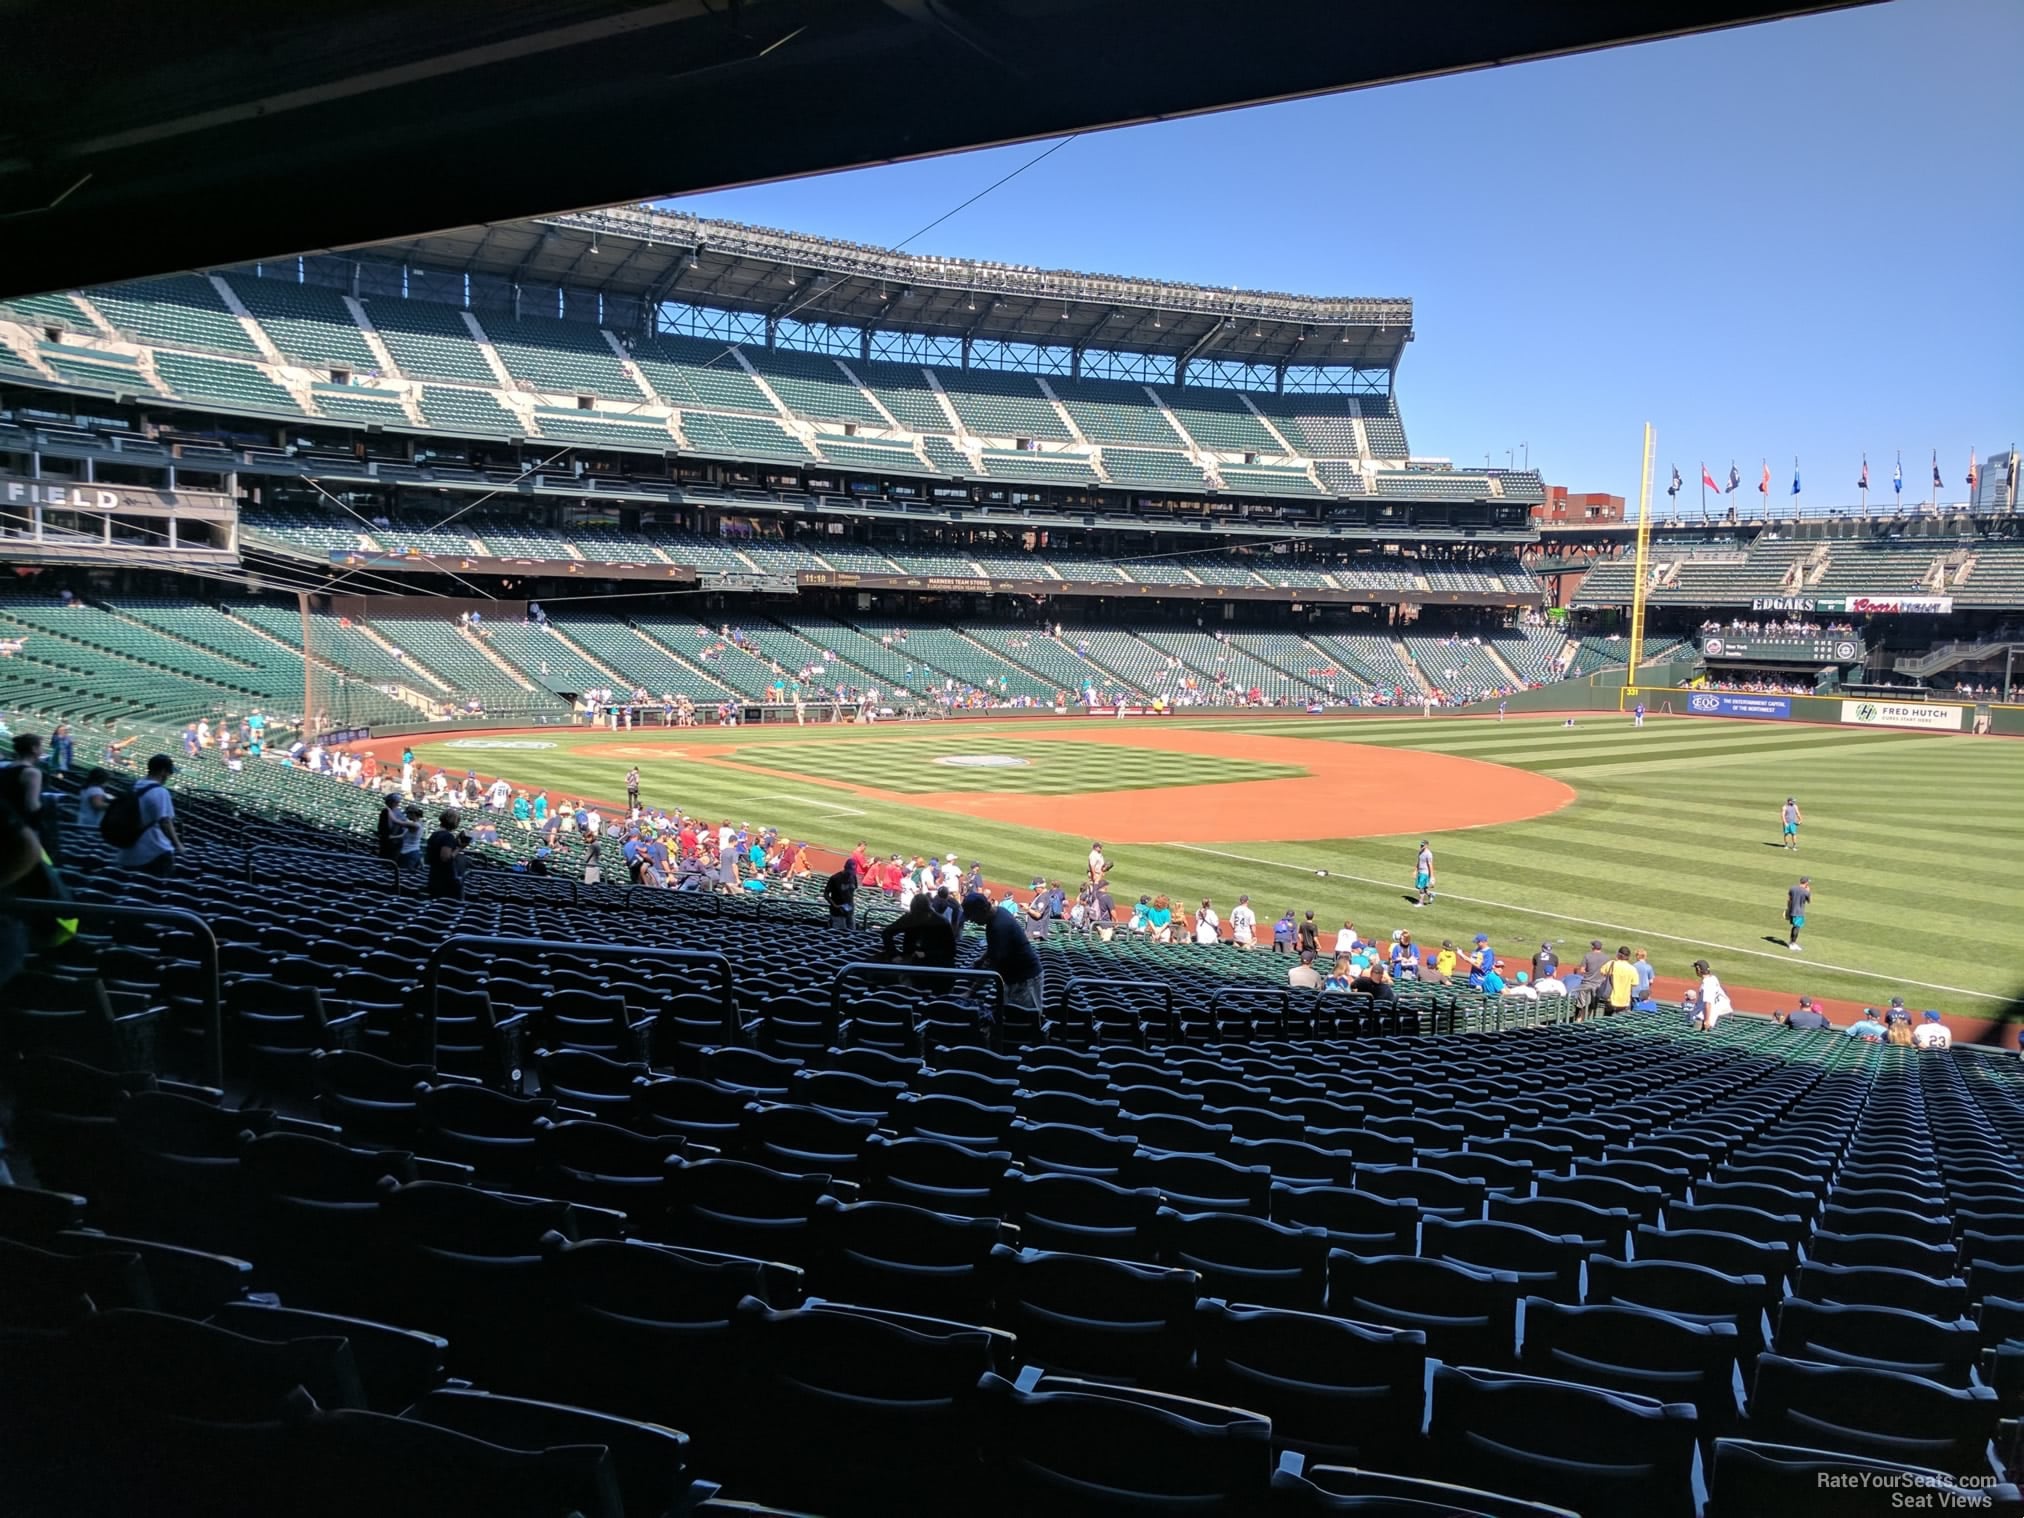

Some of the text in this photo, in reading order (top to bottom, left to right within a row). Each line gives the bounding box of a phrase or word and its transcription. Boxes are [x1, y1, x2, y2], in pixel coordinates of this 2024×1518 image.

[8, 482, 118, 509] FIELD
[805, 574, 826, 583] 11:18
[1853, 598, 1897, 614] Coors
[1627, 688, 1638, 696] 331
[1692, 698, 1720, 708] EQC
[1882, 707, 1947, 718] FRED HUTCH
[1929, 1035, 1946, 1048] 23
